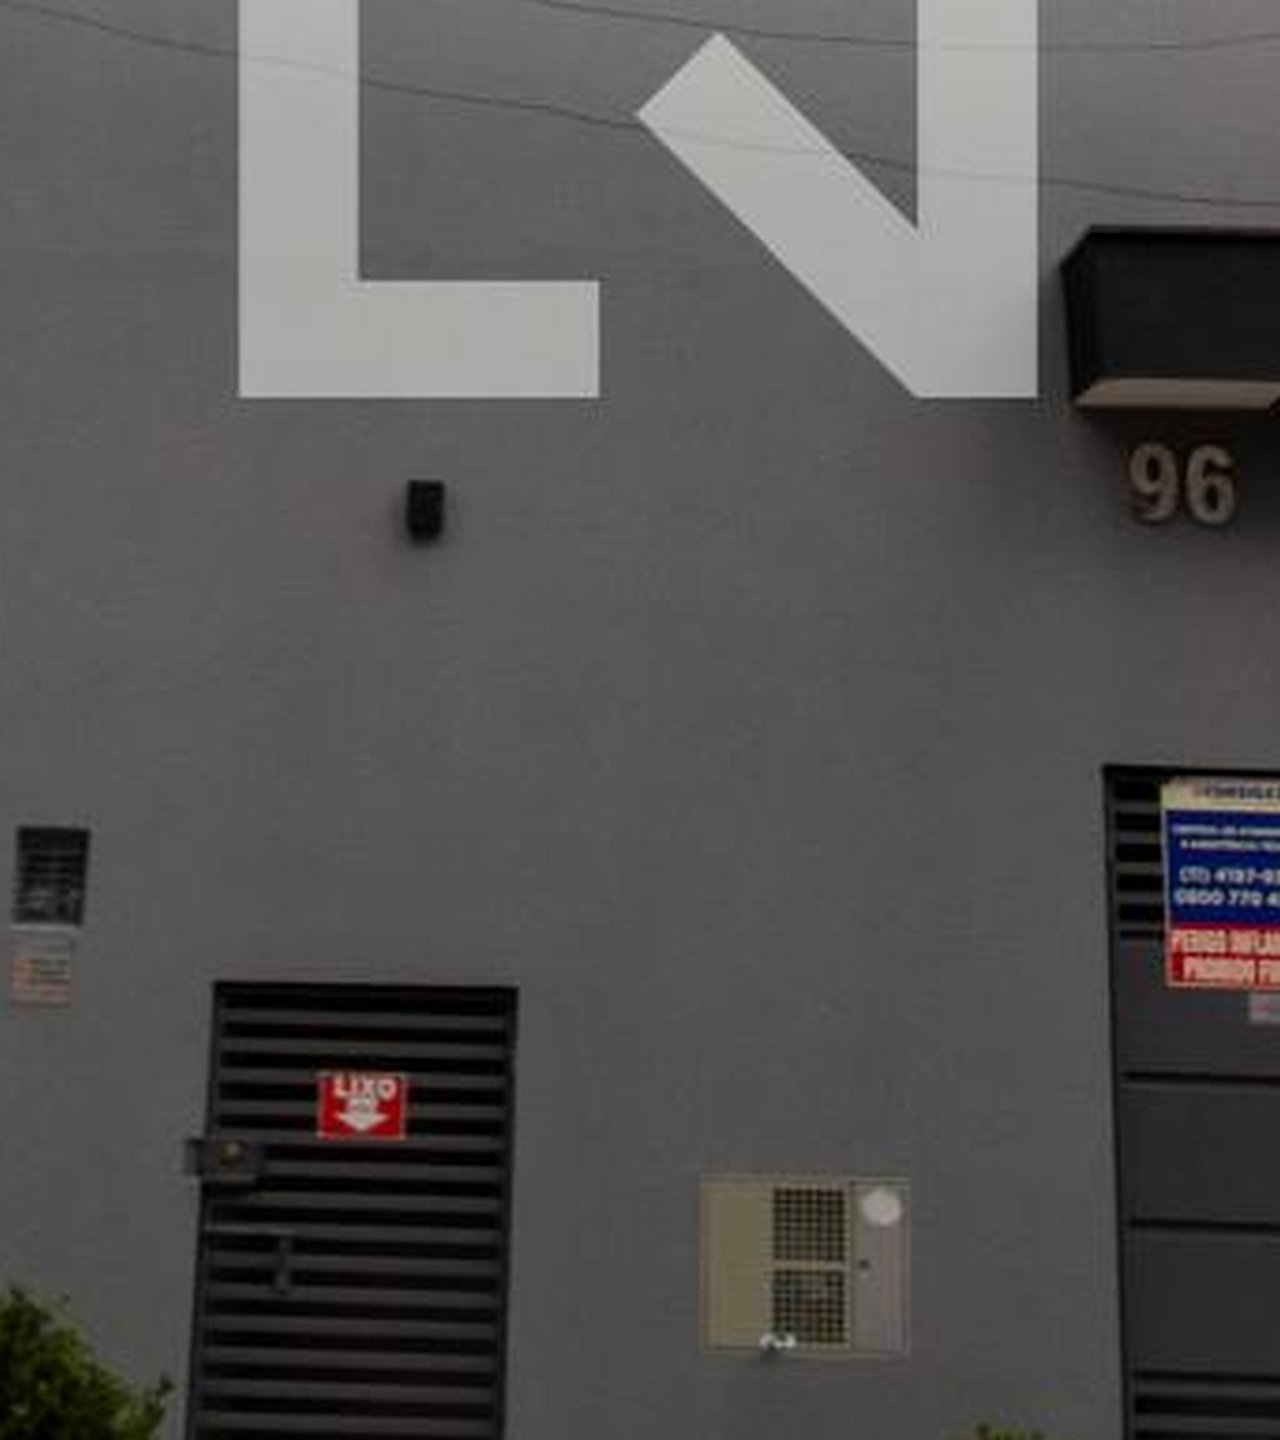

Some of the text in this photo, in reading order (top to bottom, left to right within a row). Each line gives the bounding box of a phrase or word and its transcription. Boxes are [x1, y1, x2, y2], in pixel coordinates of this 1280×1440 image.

[1129, 443, 1236, 524] 96
[1173, 887, 1224, 906] 0800
[1227, 890, 1263, 907] 770
[1171, 929, 1227, 954] PERIGO
[1182, 956, 1256, 983] PROIBIDO
[333, 1074, 398, 1101] LIXO
